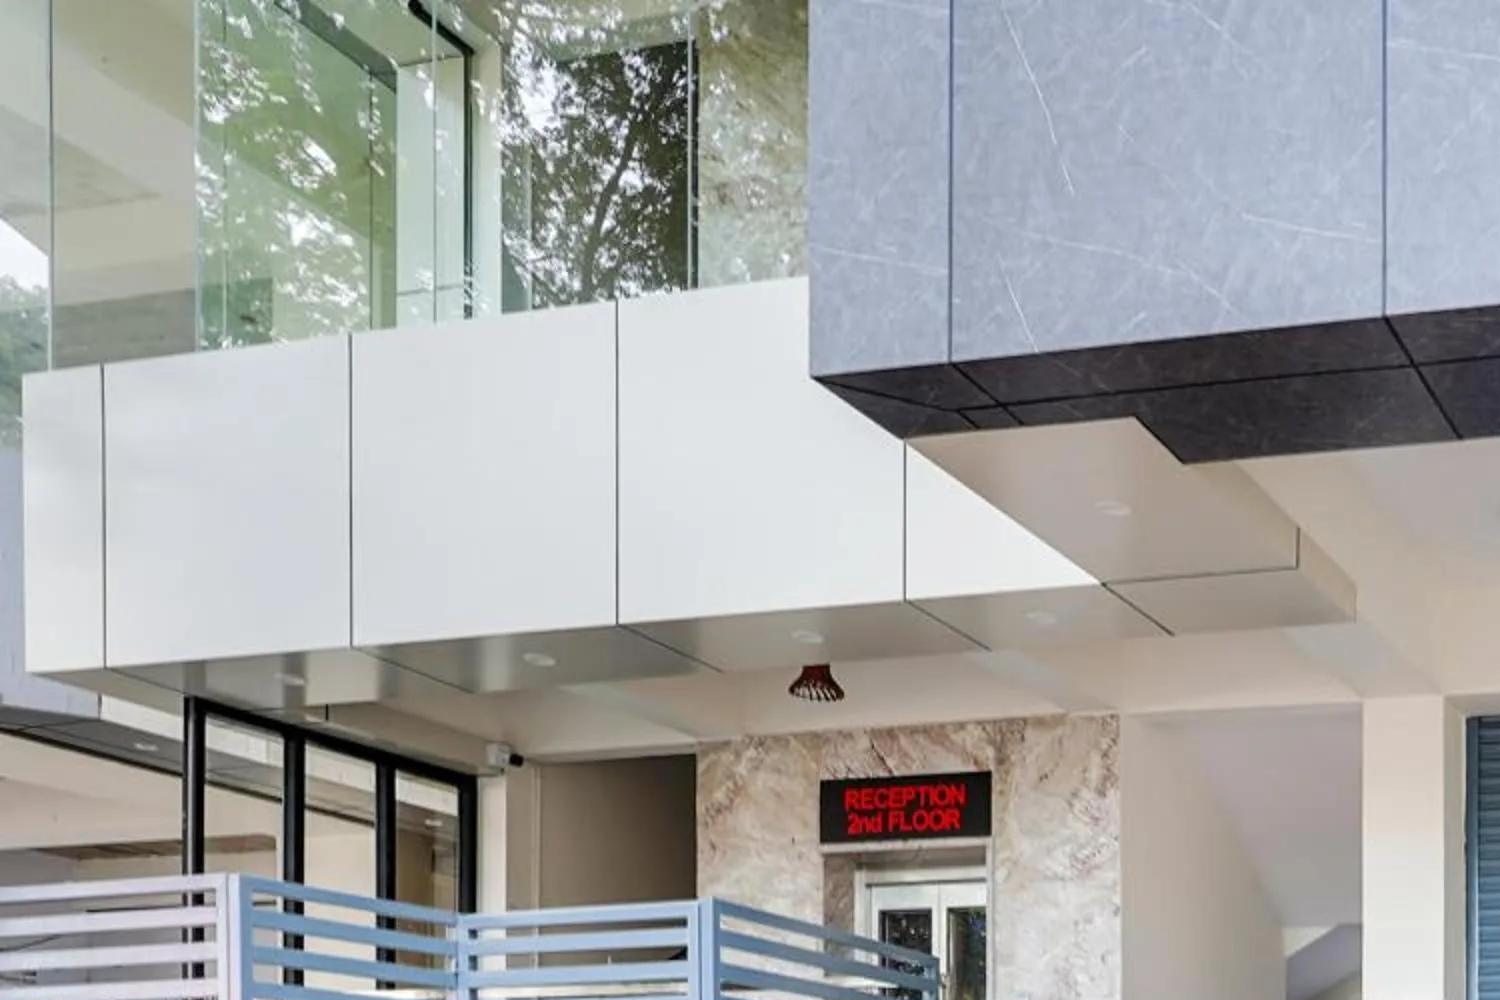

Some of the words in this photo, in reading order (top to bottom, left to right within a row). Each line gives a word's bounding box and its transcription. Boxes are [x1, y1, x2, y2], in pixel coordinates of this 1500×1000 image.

[844, 784, 966, 811] RECEPTION
[847, 812, 882, 834] 2nd
[889, 808, 961, 832] FLOOR
